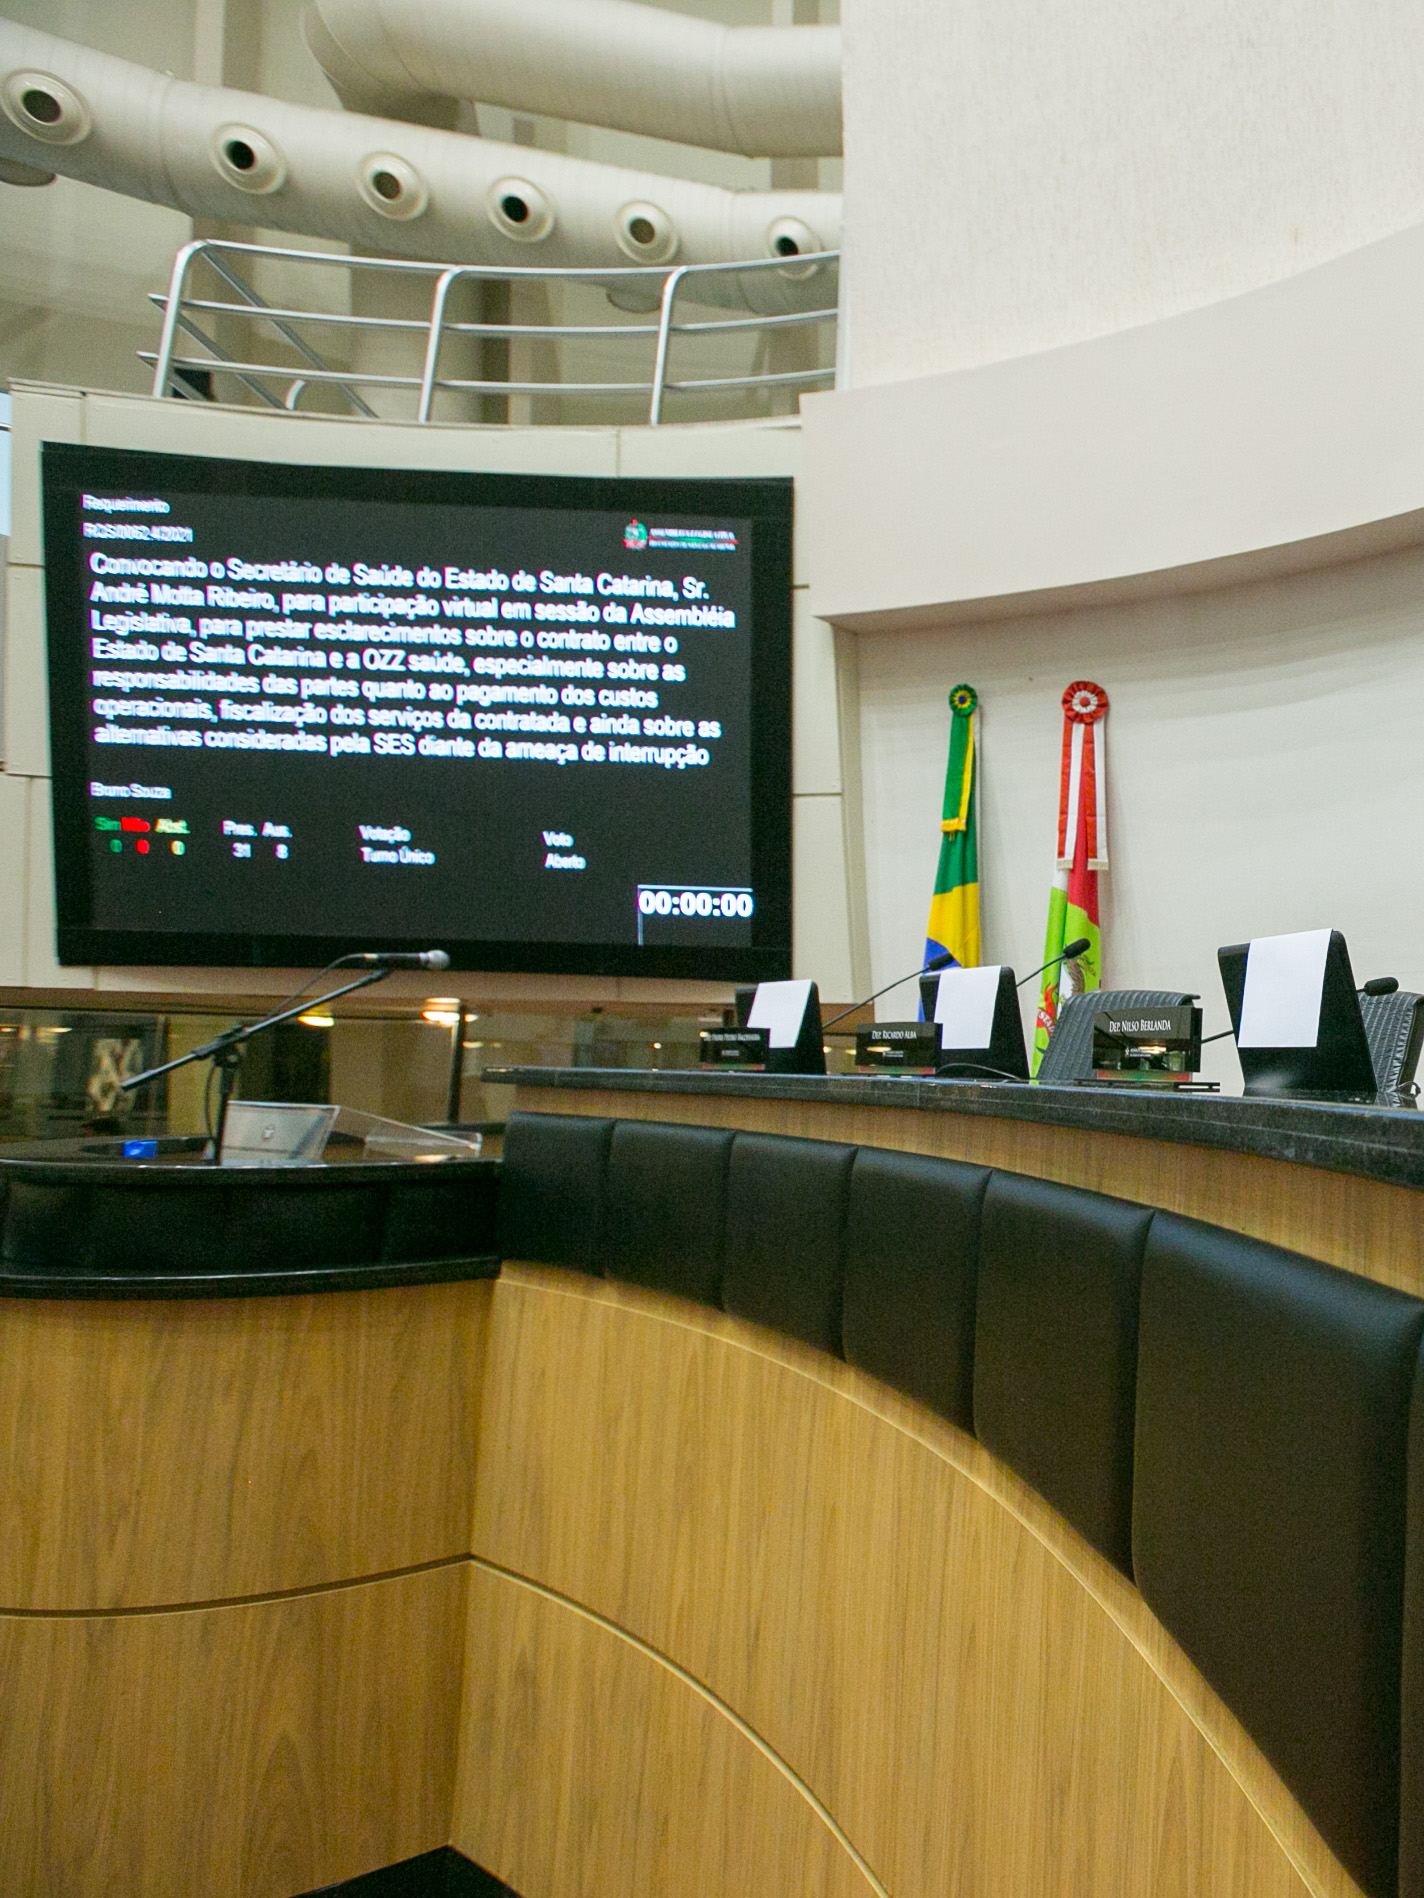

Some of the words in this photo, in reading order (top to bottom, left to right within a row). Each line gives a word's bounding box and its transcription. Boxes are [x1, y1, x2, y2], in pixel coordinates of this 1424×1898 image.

[82, 494, 171, 514] Requerimento
[89, 552, 209, 579] Convocando
[209, 562, 226, 579] o
[226, 557, 324, 584] Secretário
[325, 562, 351, 586] de
[352, 563, 414, 588] Saúde
[415, 566, 443, 588] do
[444, 567, 509, 591] Estado
[511, 570, 537, 592] de
[539, 570, 594, 595] Santa
[596, 572, 679, 602] Catarina,
[681, 576, 710, 600] Sr.
[89, 581, 149, 604] André
[150, 583, 205, 606] Motta
[206, 585, 279, 613] Ribeiro,
[281, 593, 326, 615] para
[327, 592, 440, 620] participação
[440, 596, 498, 619] virtual
[500, 602, 532, 620] em
[534, 600, 600, 622] sessão
[602, 601, 628, 624] da
[90, 609, 197, 638] Legislativa,
[197, 618, 244, 640] para
[244, 618, 312, 641] prestar
[313, 619, 462, 643] esclarecimentos
[464, 625, 518, 647] sobre
[519, 630, 535, 648] o
[536, 629, 611, 652] contrato
[613, 631, 661, 653] entre
[663, 636, 678, 654] o
[91, 637, 160, 661] Estado
[161, 640, 188, 662] de
[188, 641, 246, 665] Santa
[247, 643, 327, 668] Catarina
[328, 651, 344, 670] e
[345, 652, 361, 670] a
[362, 648, 407, 671] OZZ
[407, 650, 471, 677] saúde,
[472, 654, 604, 679] especialmente
[606, 658, 659, 680] sobre
[661, 663, 686, 682] as
[91, 669, 260, 693] responsabilidades
[261, 673, 299, 695] das
[300, 676, 360, 700] partes
[361, 678, 427, 703] quanto
[428, 682, 454, 701] ao
[455, 684, 558, 706] pagamento
[560, 684, 595, 705] dos
[597, 687, 659, 708] custos
[91, 696, 218, 723] operacionais,
[218, 698, 328, 727] fiscalização
[329, 703, 366, 726] dos
[366, 705, 445, 732] serviços
[446, 707, 472, 730] da
[474, 710, 571, 733] contratada
[572, 715, 587, 734] e
[588, 712, 641, 735] ainda
[642, 715, 695, 737] sobre
[697, 721, 722, 738] as
[93, 723, 203, 747] alternativas
[203, 728, 328, 752] consideradas
[329, 731, 371, 757] pela
[372, 731, 417, 755] SES
[417, 734, 476, 757] diante
[477, 737, 503, 758] da
[505, 741, 579, 765] ameaça
[580, 740, 606, 762] de
[608, 740, 710, 769] interrupção
[358, 825, 412, 844] Votação
[541, 831, 574, 847] Voto
[360, 847, 399, 863] Turno
[398, 845, 436, 865] Único
[544, 853, 587, 869] Aberto
[638, 890, 754, 918] 00:00:00
[1121, 1020, 1139, 1032] NILSO
[1140, 1019, 1171, 1031] BERLANDA
